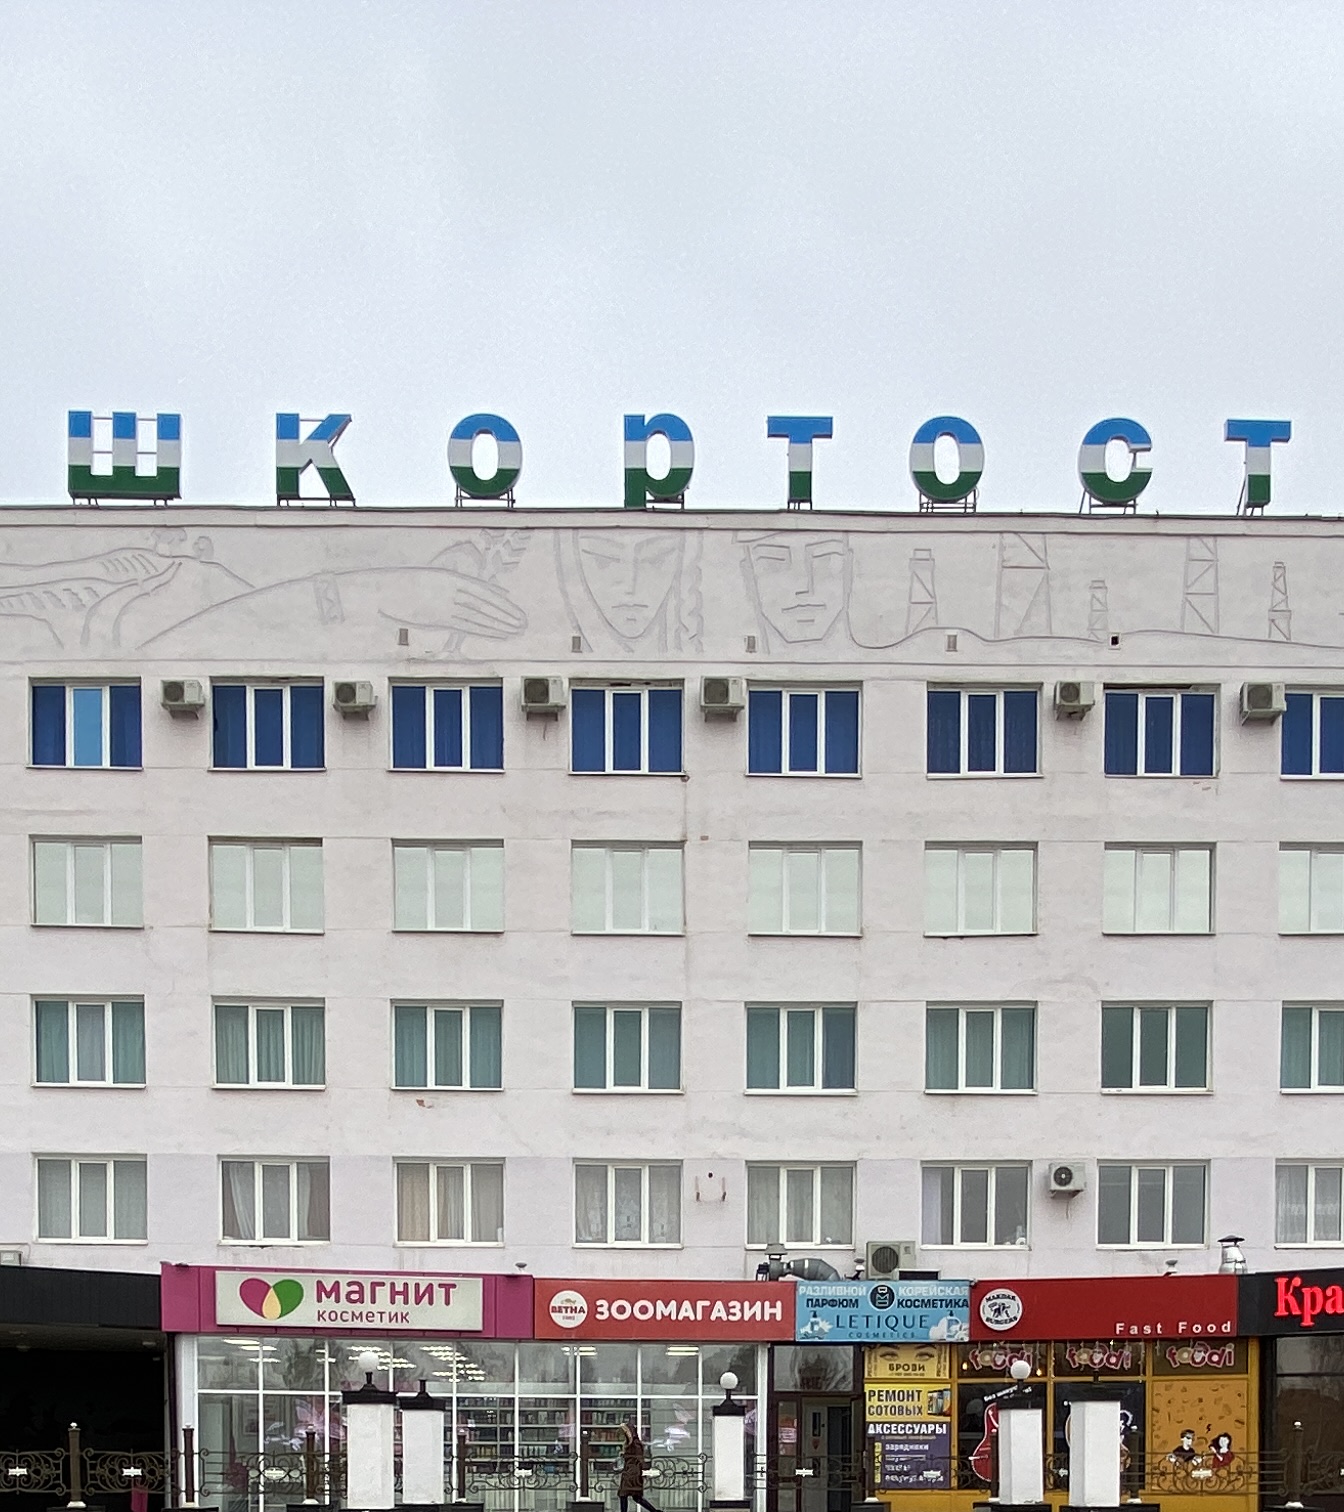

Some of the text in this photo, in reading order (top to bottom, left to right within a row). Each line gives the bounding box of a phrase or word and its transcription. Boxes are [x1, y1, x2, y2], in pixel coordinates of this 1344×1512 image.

[799, 1286, 867, 1297] РАЗЛИВНОЙ
[898, 1286, 969, 1297] КОРЕЙСКАЯ
[806, 1298, 859, 1309] ПАРФЮМ
[897, 1299, 969, 1309] КОСМЕТИКА
[595, 1300, 782, 1321] ЗООМАГАЗИН
[317, 1310, 409, 1323] косметик
[836, 1314, 930, 1332] LETIQUE
[1115, 1321, 1231, 1335] Fast Food
[888, 1363, 926, 1372] БРОВИ
[868, 1389, 923, 1402] РЕМОНТ
[868, 1405, 923, 1416] СОТОВЫХ
[867, 1423, 947, 1434] АКСЕССУАРЫ
